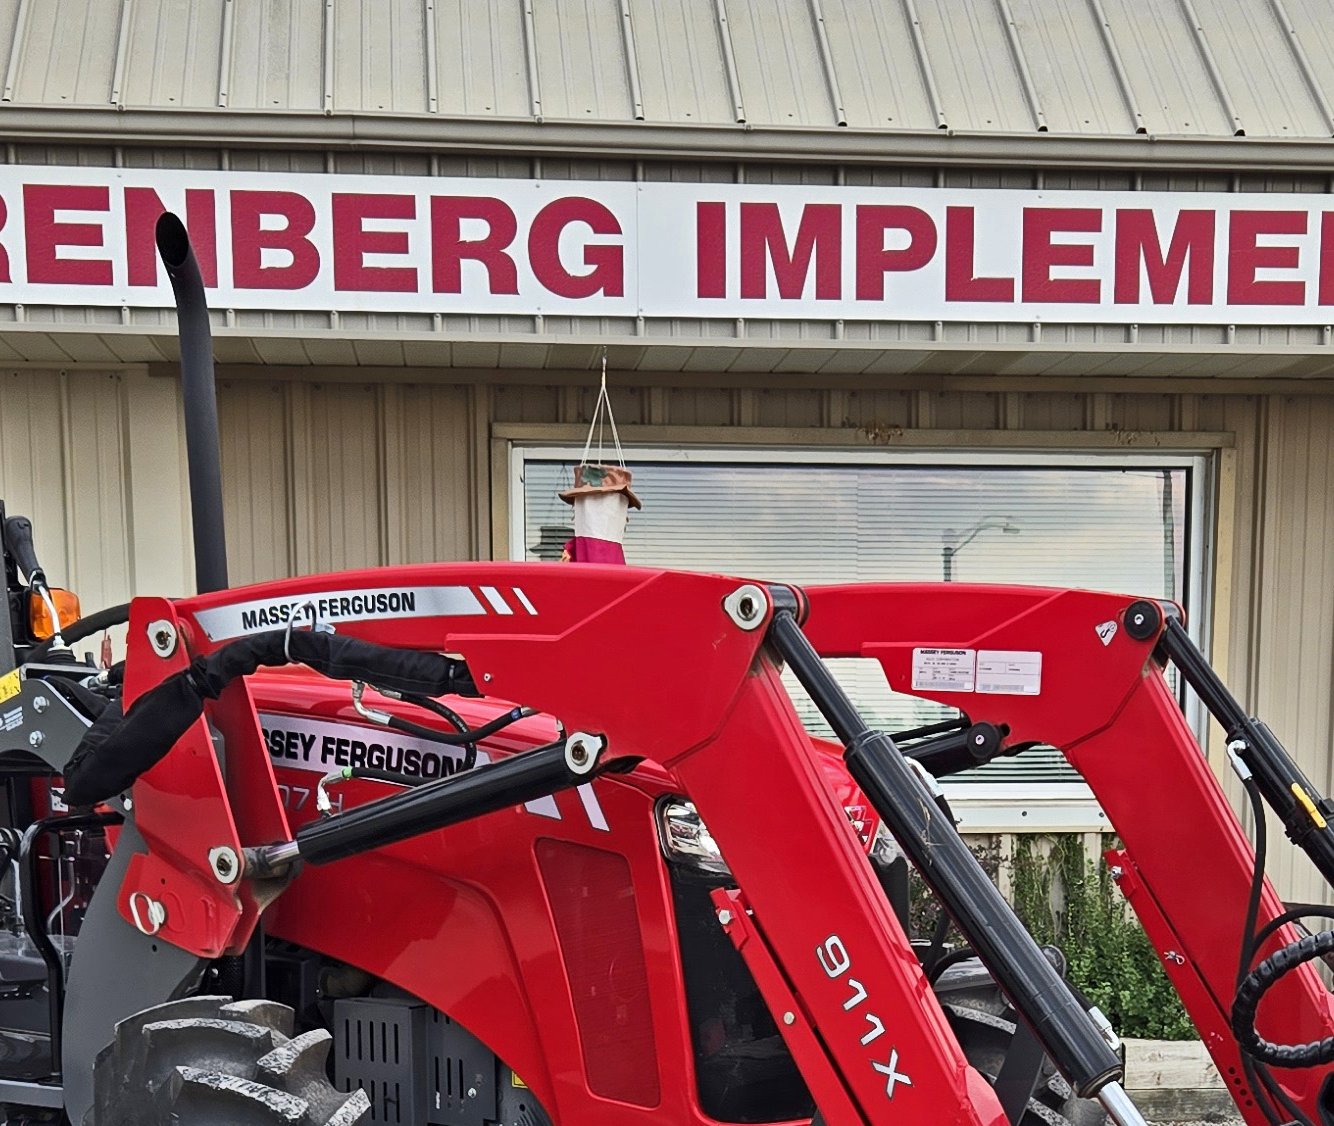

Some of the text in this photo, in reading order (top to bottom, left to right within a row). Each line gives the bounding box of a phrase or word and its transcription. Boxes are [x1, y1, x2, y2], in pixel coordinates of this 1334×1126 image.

[241, 591, 416, 630] MASSEY FERGUSON
[321, 735, 463, 777] FERGUSON
[816, 933, 913, 1101] 911X
